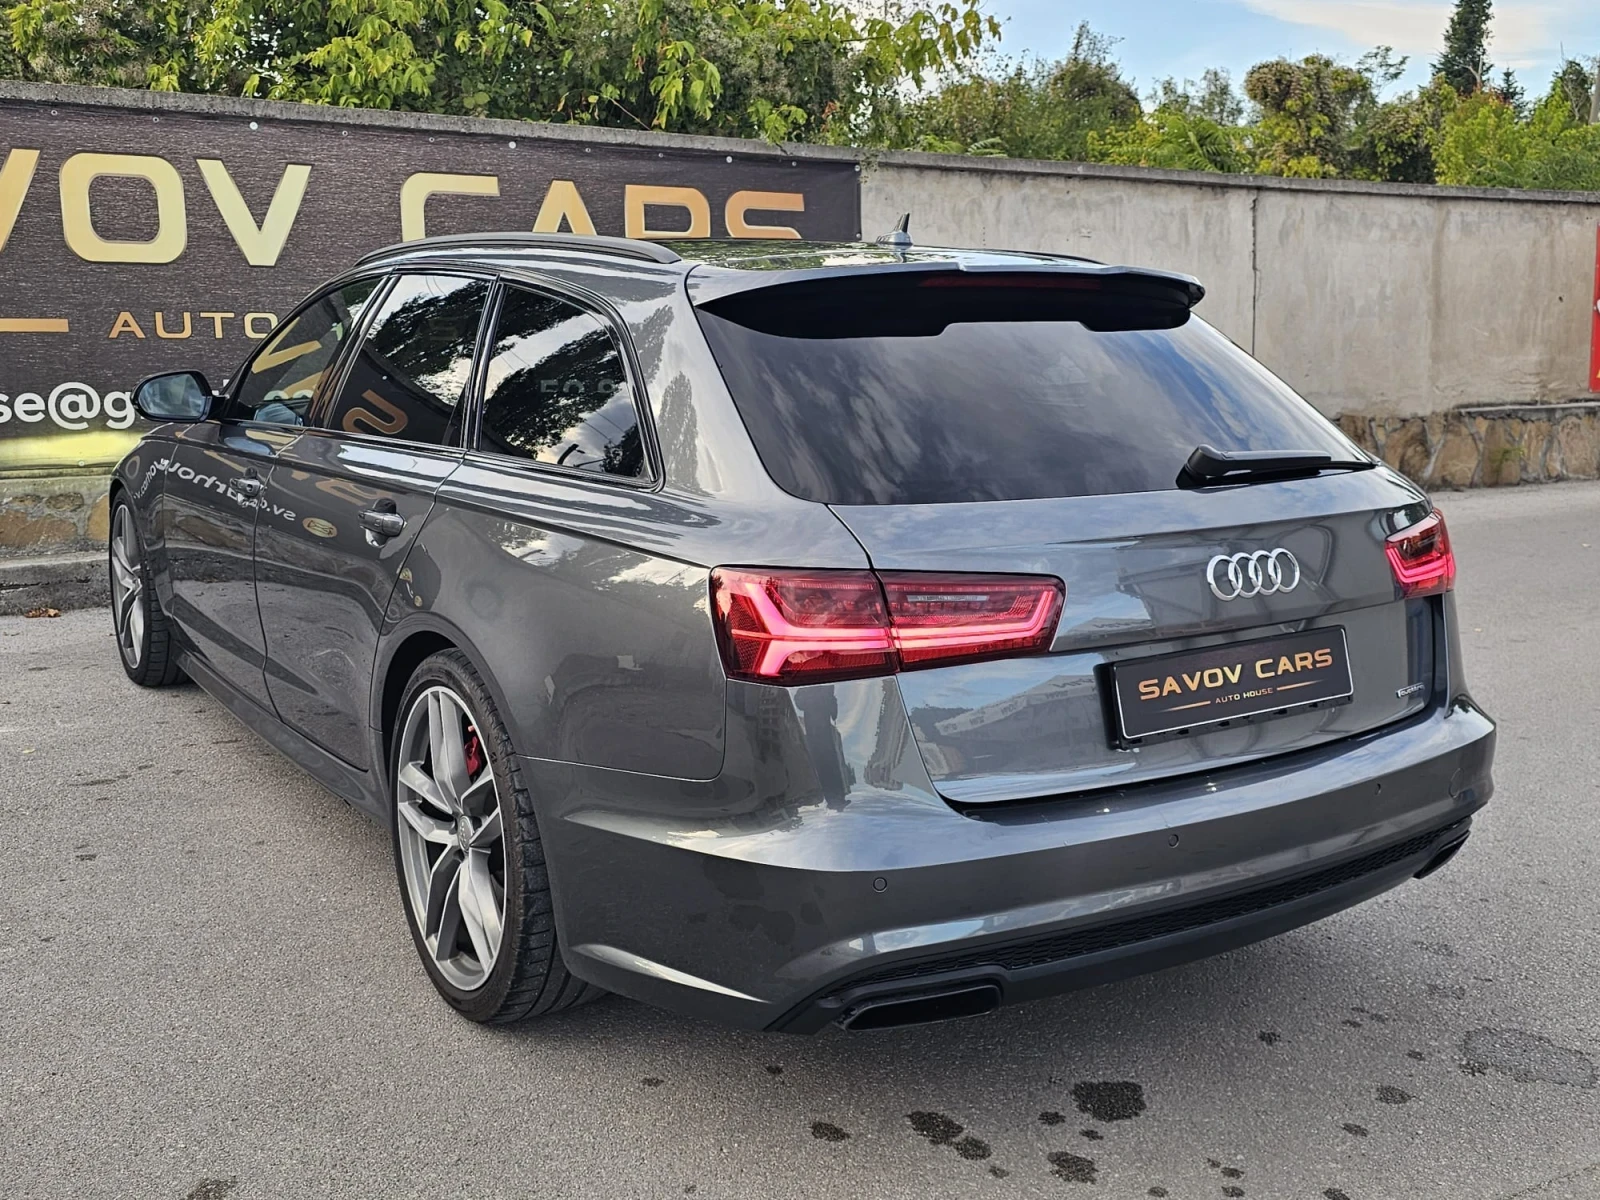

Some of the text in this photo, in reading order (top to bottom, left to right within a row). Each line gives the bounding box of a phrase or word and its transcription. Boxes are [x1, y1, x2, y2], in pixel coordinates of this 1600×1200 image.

[108, 311, 280, 339] AUTO
[1138, 648, 1333, 700] SAVOV CARS
[1215, 687, 1274, 704] AUTO HOUSE
